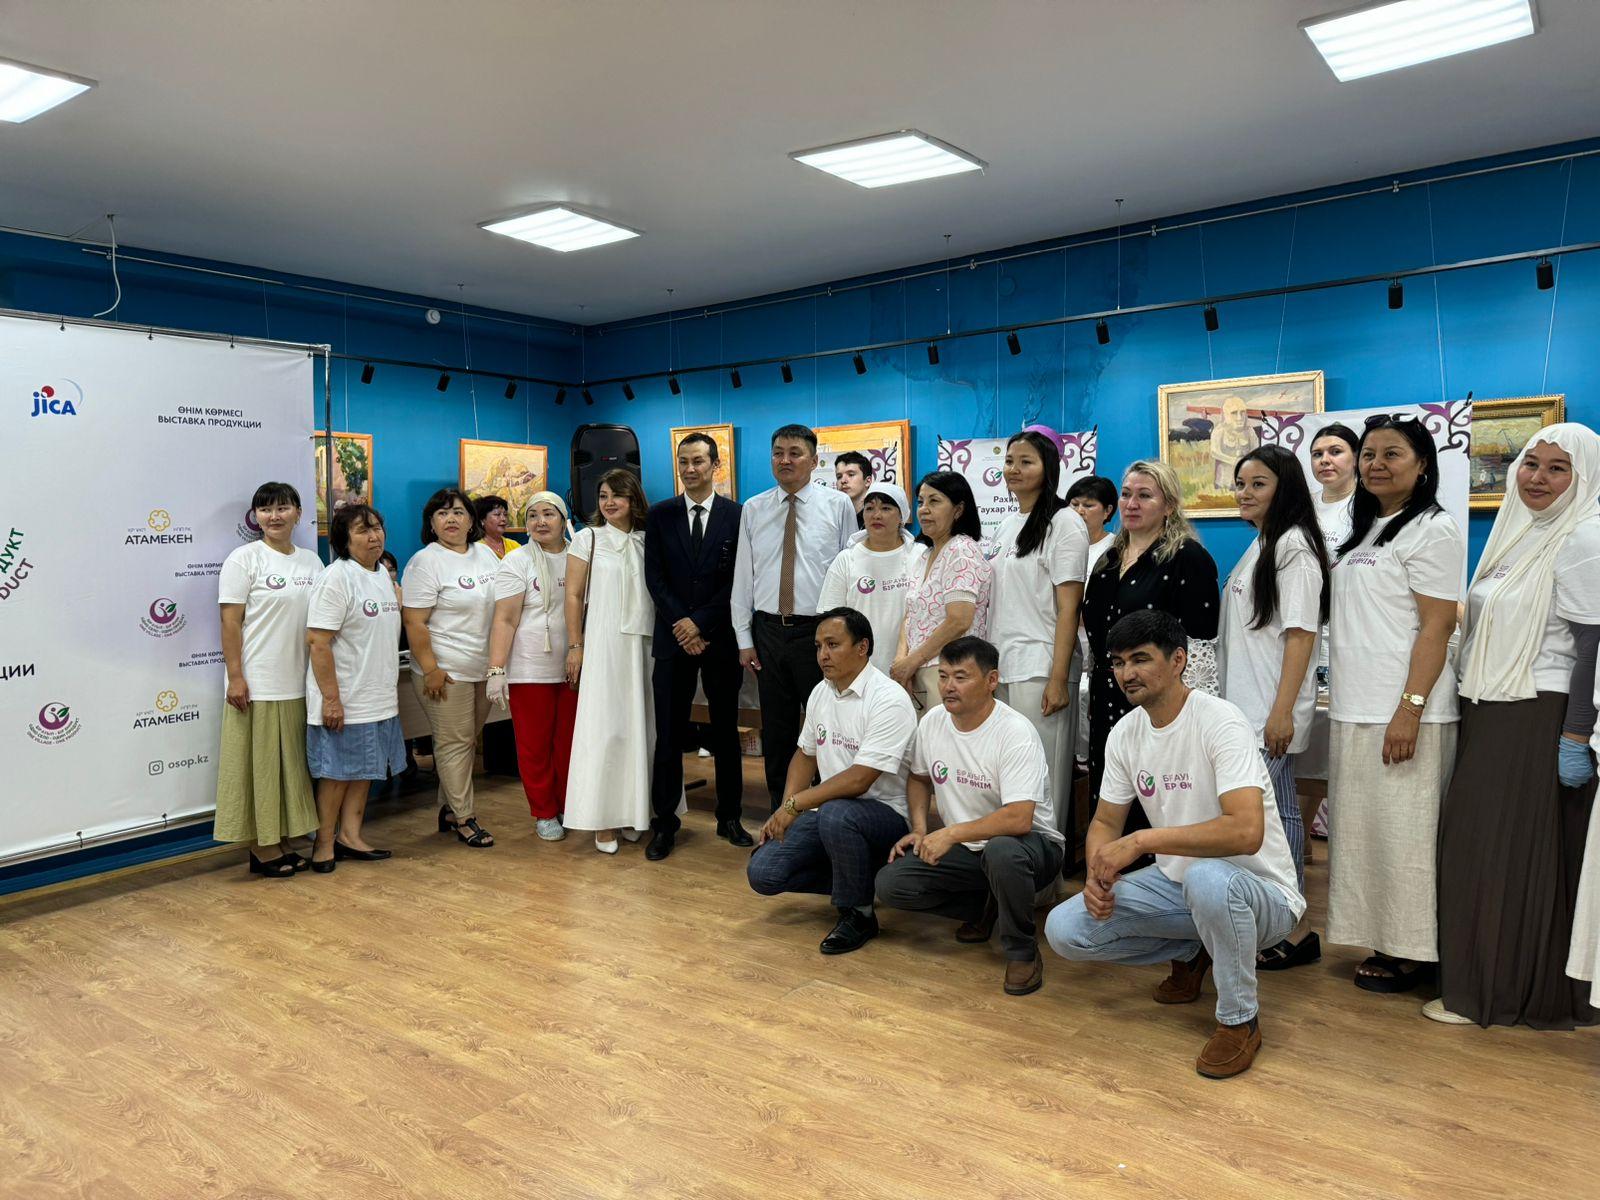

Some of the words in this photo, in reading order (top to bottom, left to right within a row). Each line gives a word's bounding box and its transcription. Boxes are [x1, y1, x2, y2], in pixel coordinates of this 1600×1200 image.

[177, 405, 203, 415] ӨНІМ
[205, 407, 243, 418] КӨРМЕСІ
[157, 415, 206, 426] ВЫСТАВКА
[207, 418, 262, 429] ПРОДУКЦИИ
[1007, 504, 1019, 513] Ка
[124, 533, 193, 545] АТАМЕКЕН
[178, 659, 209, 668] ВЫСТАВКА
[132, 710, 200, 729] АТАМЕКЕН
[168, 754, 209, 769] osop.kz
[969, 779, 992, 790] ӨНІМ
